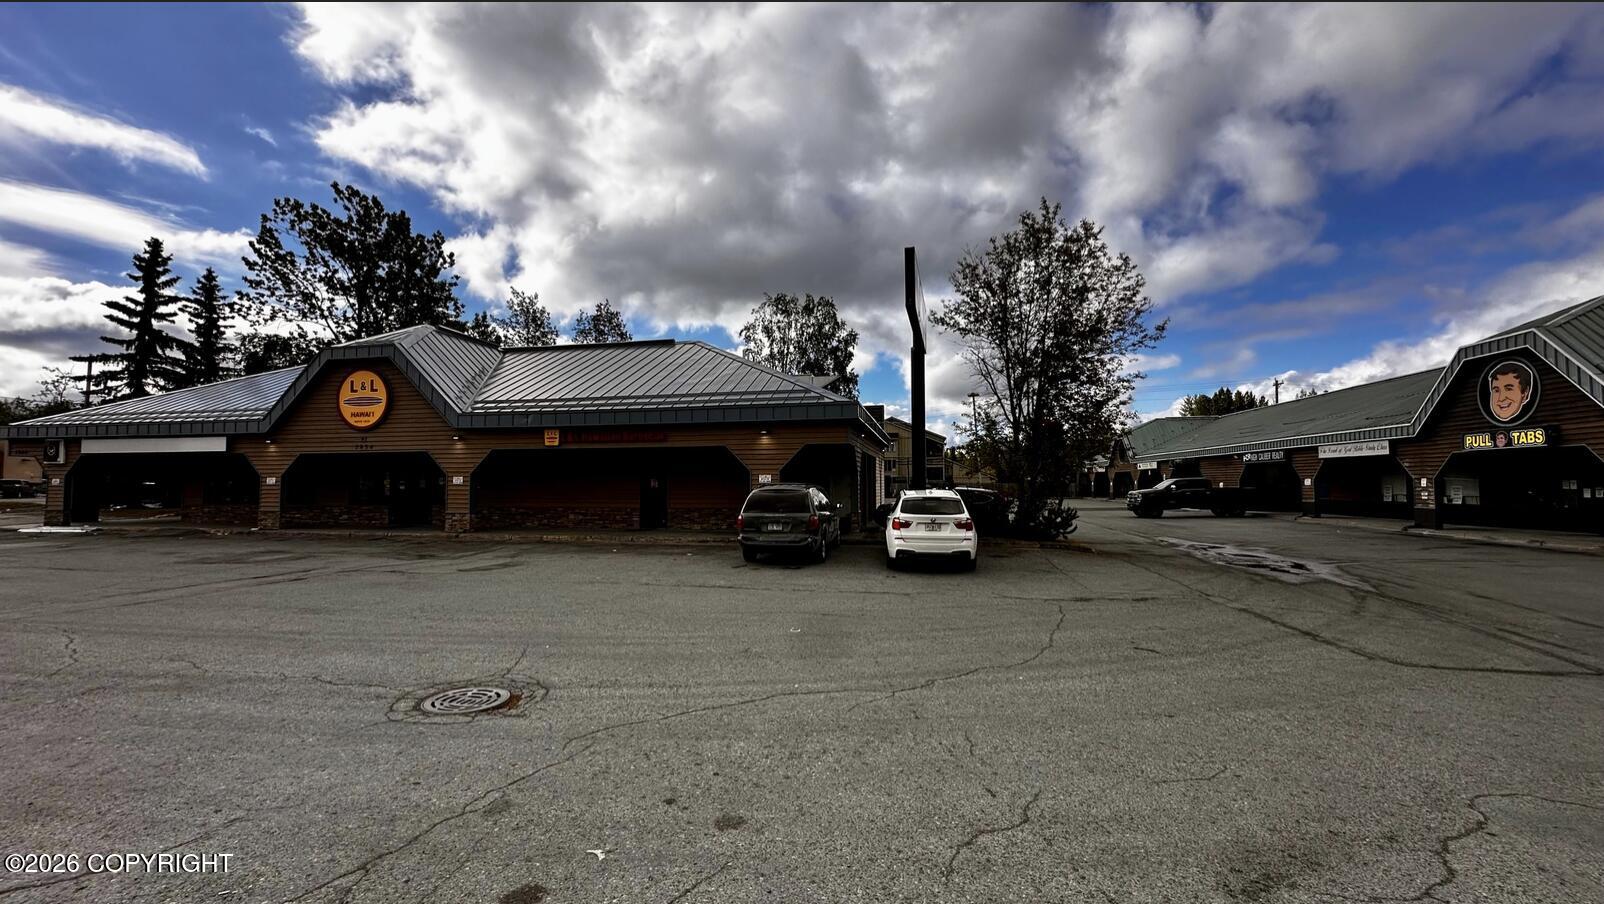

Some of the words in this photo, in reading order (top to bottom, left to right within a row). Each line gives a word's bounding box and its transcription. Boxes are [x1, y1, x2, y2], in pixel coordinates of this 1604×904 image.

[350, 379, 358, 393] L
[360, 381, 367, 391] &
[370, 379, 378, 392] L
[1464, 434, 1493, 448] PULL
[1511, 429, 1546, 445] TABS
